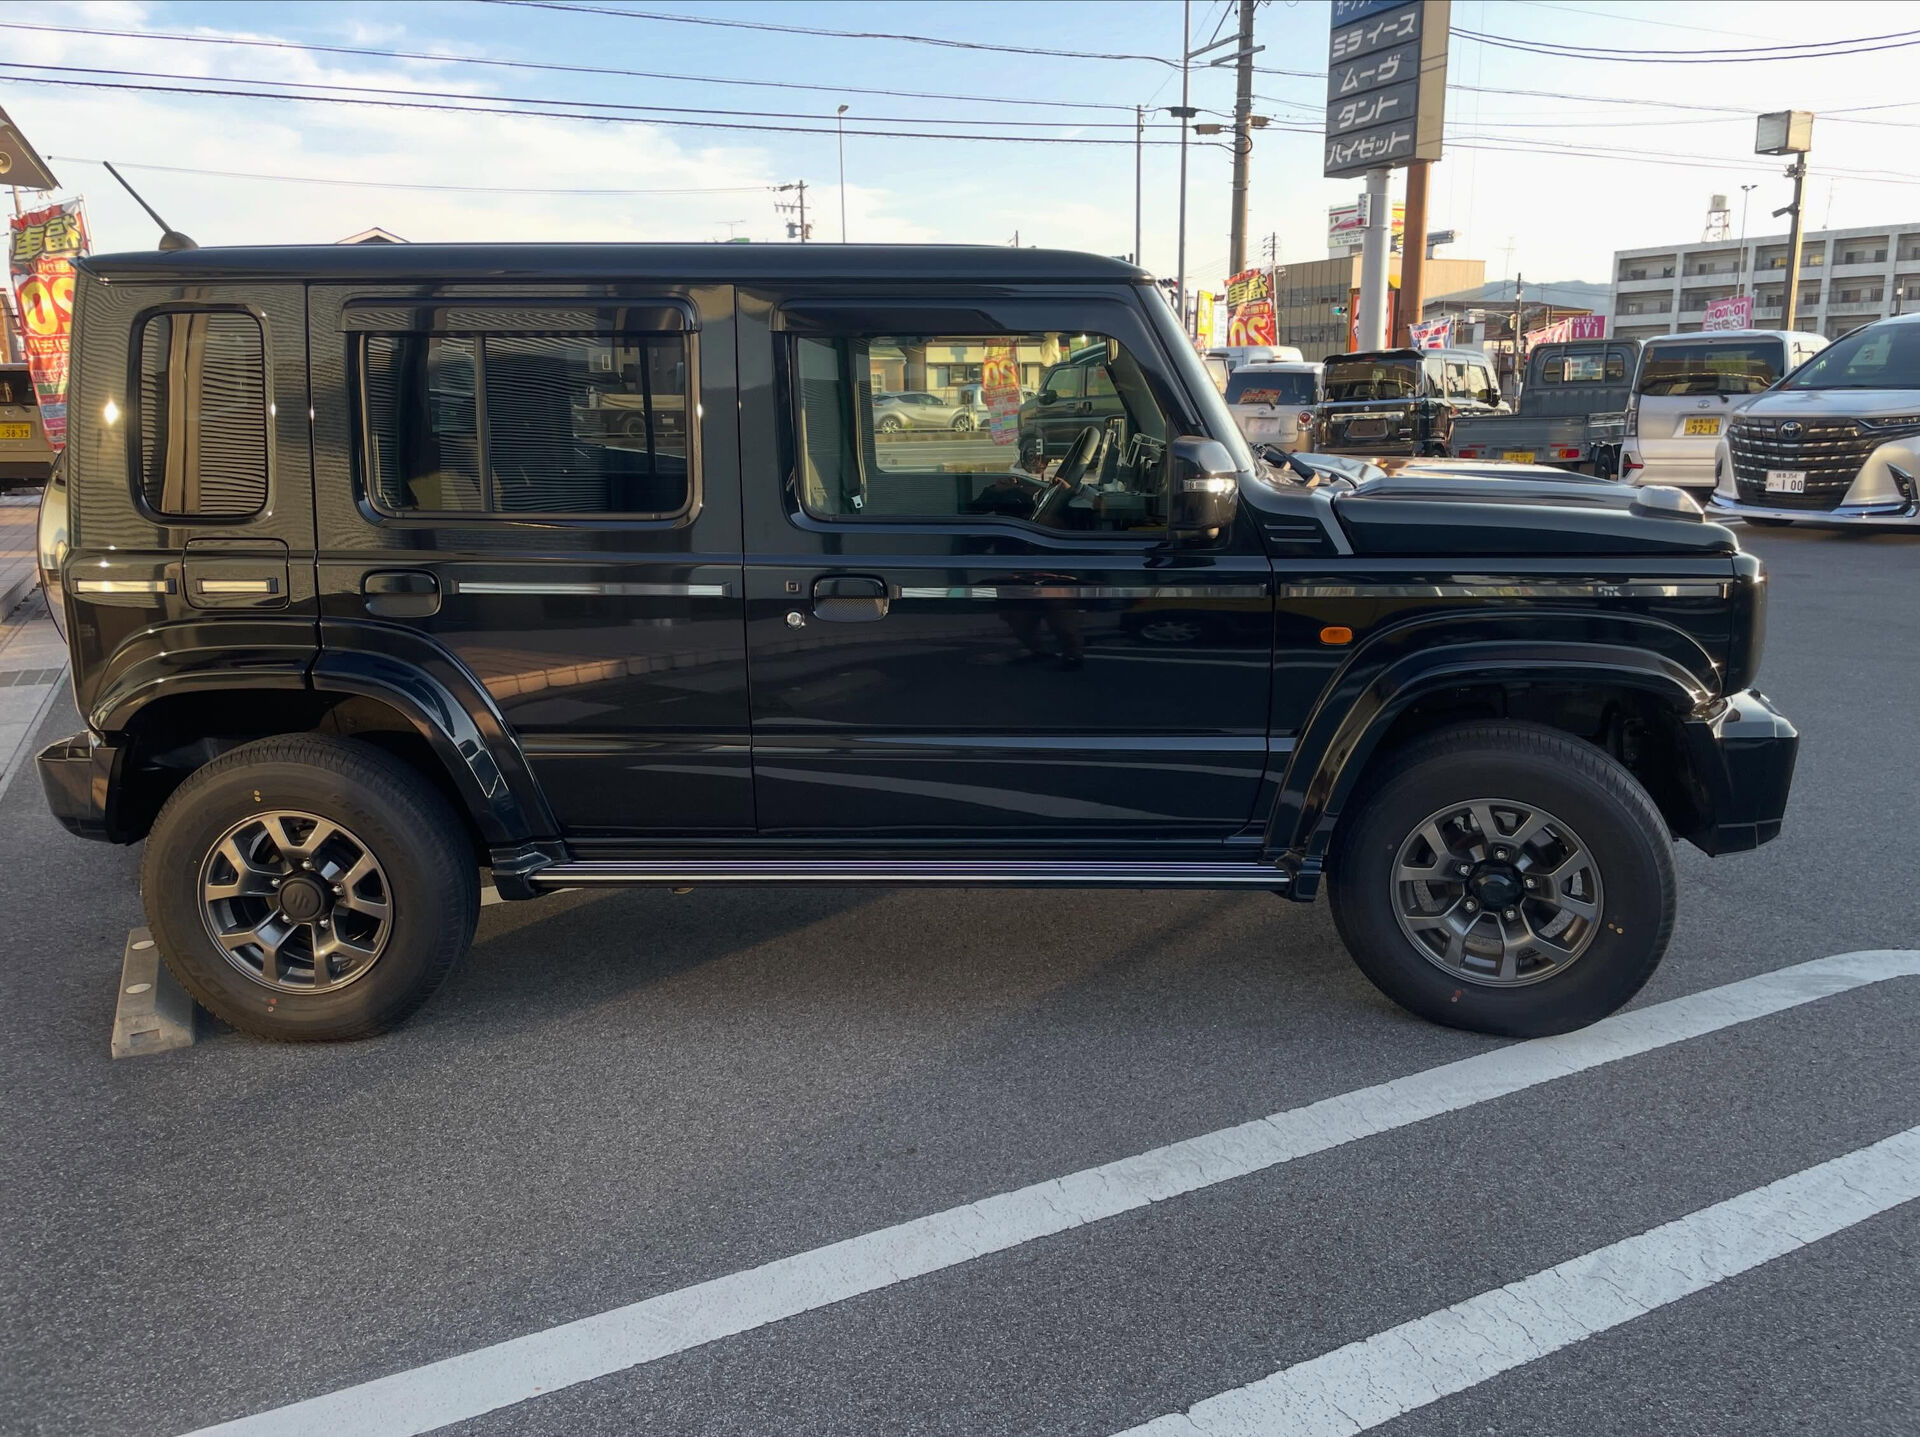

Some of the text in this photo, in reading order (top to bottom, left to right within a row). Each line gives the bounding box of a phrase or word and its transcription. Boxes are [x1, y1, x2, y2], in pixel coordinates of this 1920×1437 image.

[1340, 54, 1401, 92] ムーヴ
[1338, 96, 1398, 128] タント
[1326, 131, 1410, 166] ハイゼット
